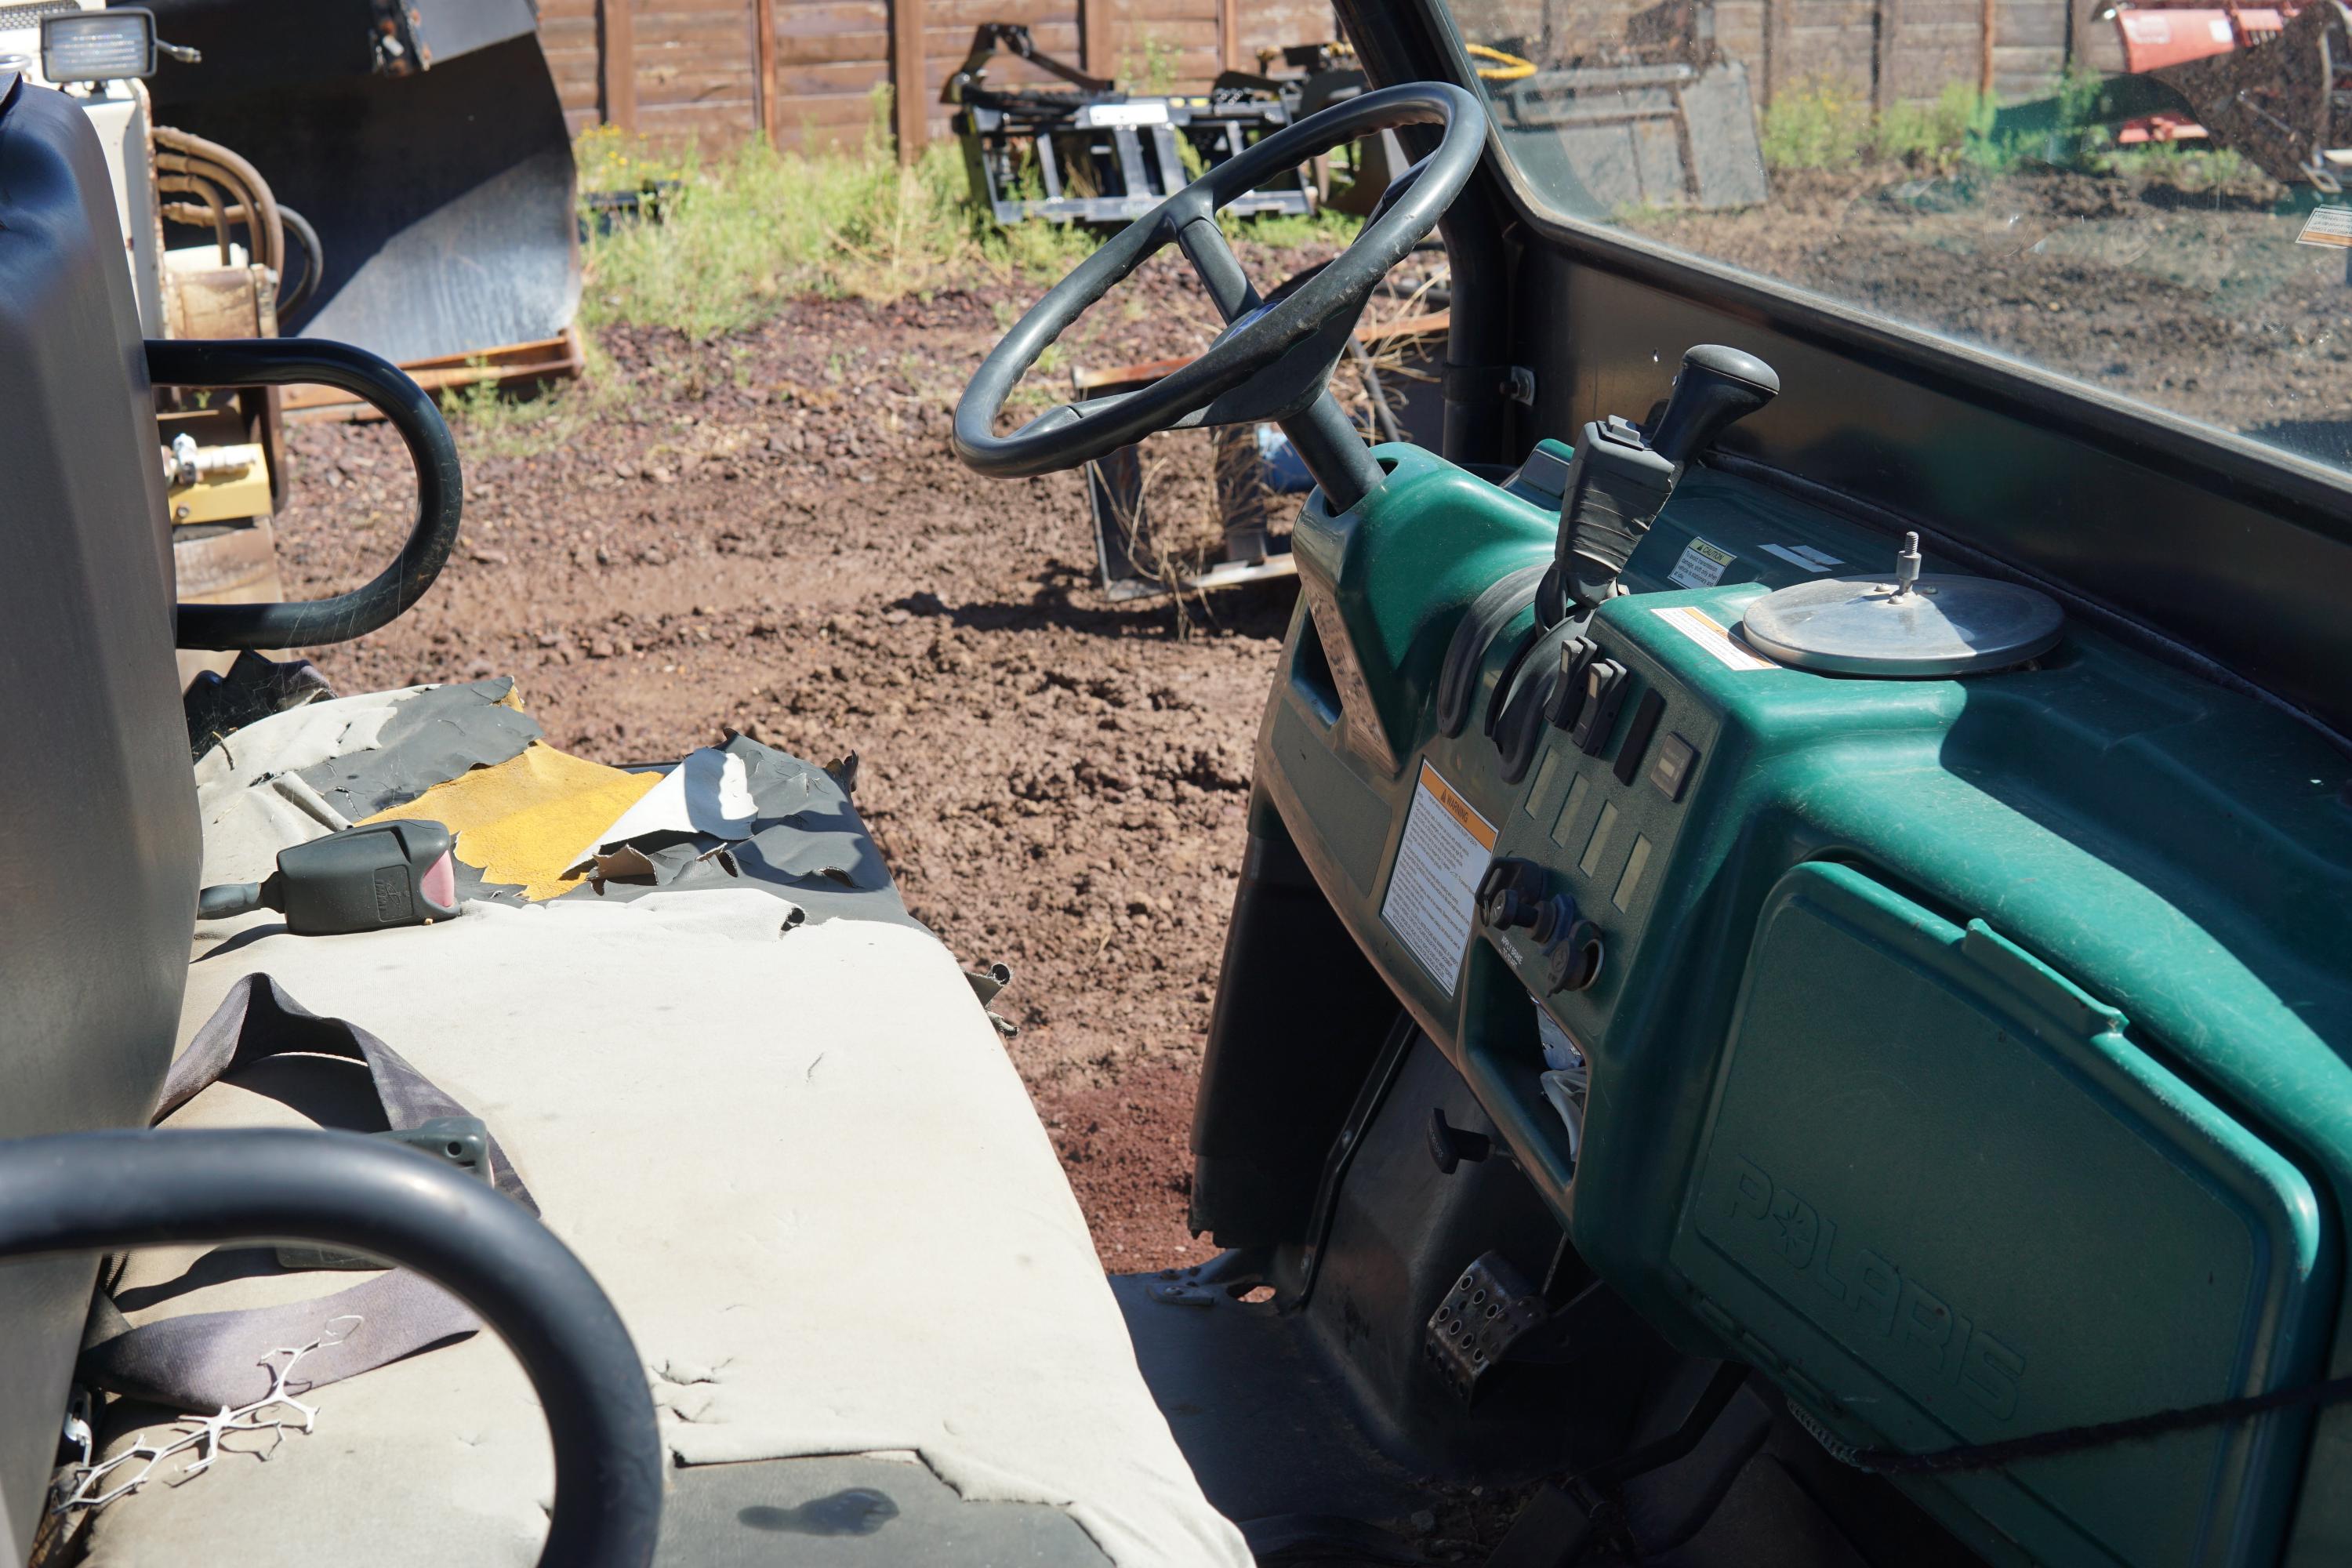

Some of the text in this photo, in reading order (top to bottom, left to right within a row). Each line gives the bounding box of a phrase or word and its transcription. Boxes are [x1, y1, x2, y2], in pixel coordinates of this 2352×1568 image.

[1703, 546, 1724, 561] CAUTION
[1446, 795, 1468, 822] WARNING
[1501, 935, 1523, 964] APPLY BRAKE
[1503, 947, 1518, 969] TO START
[1723, 1152, 2025, 1421] POLARIS
